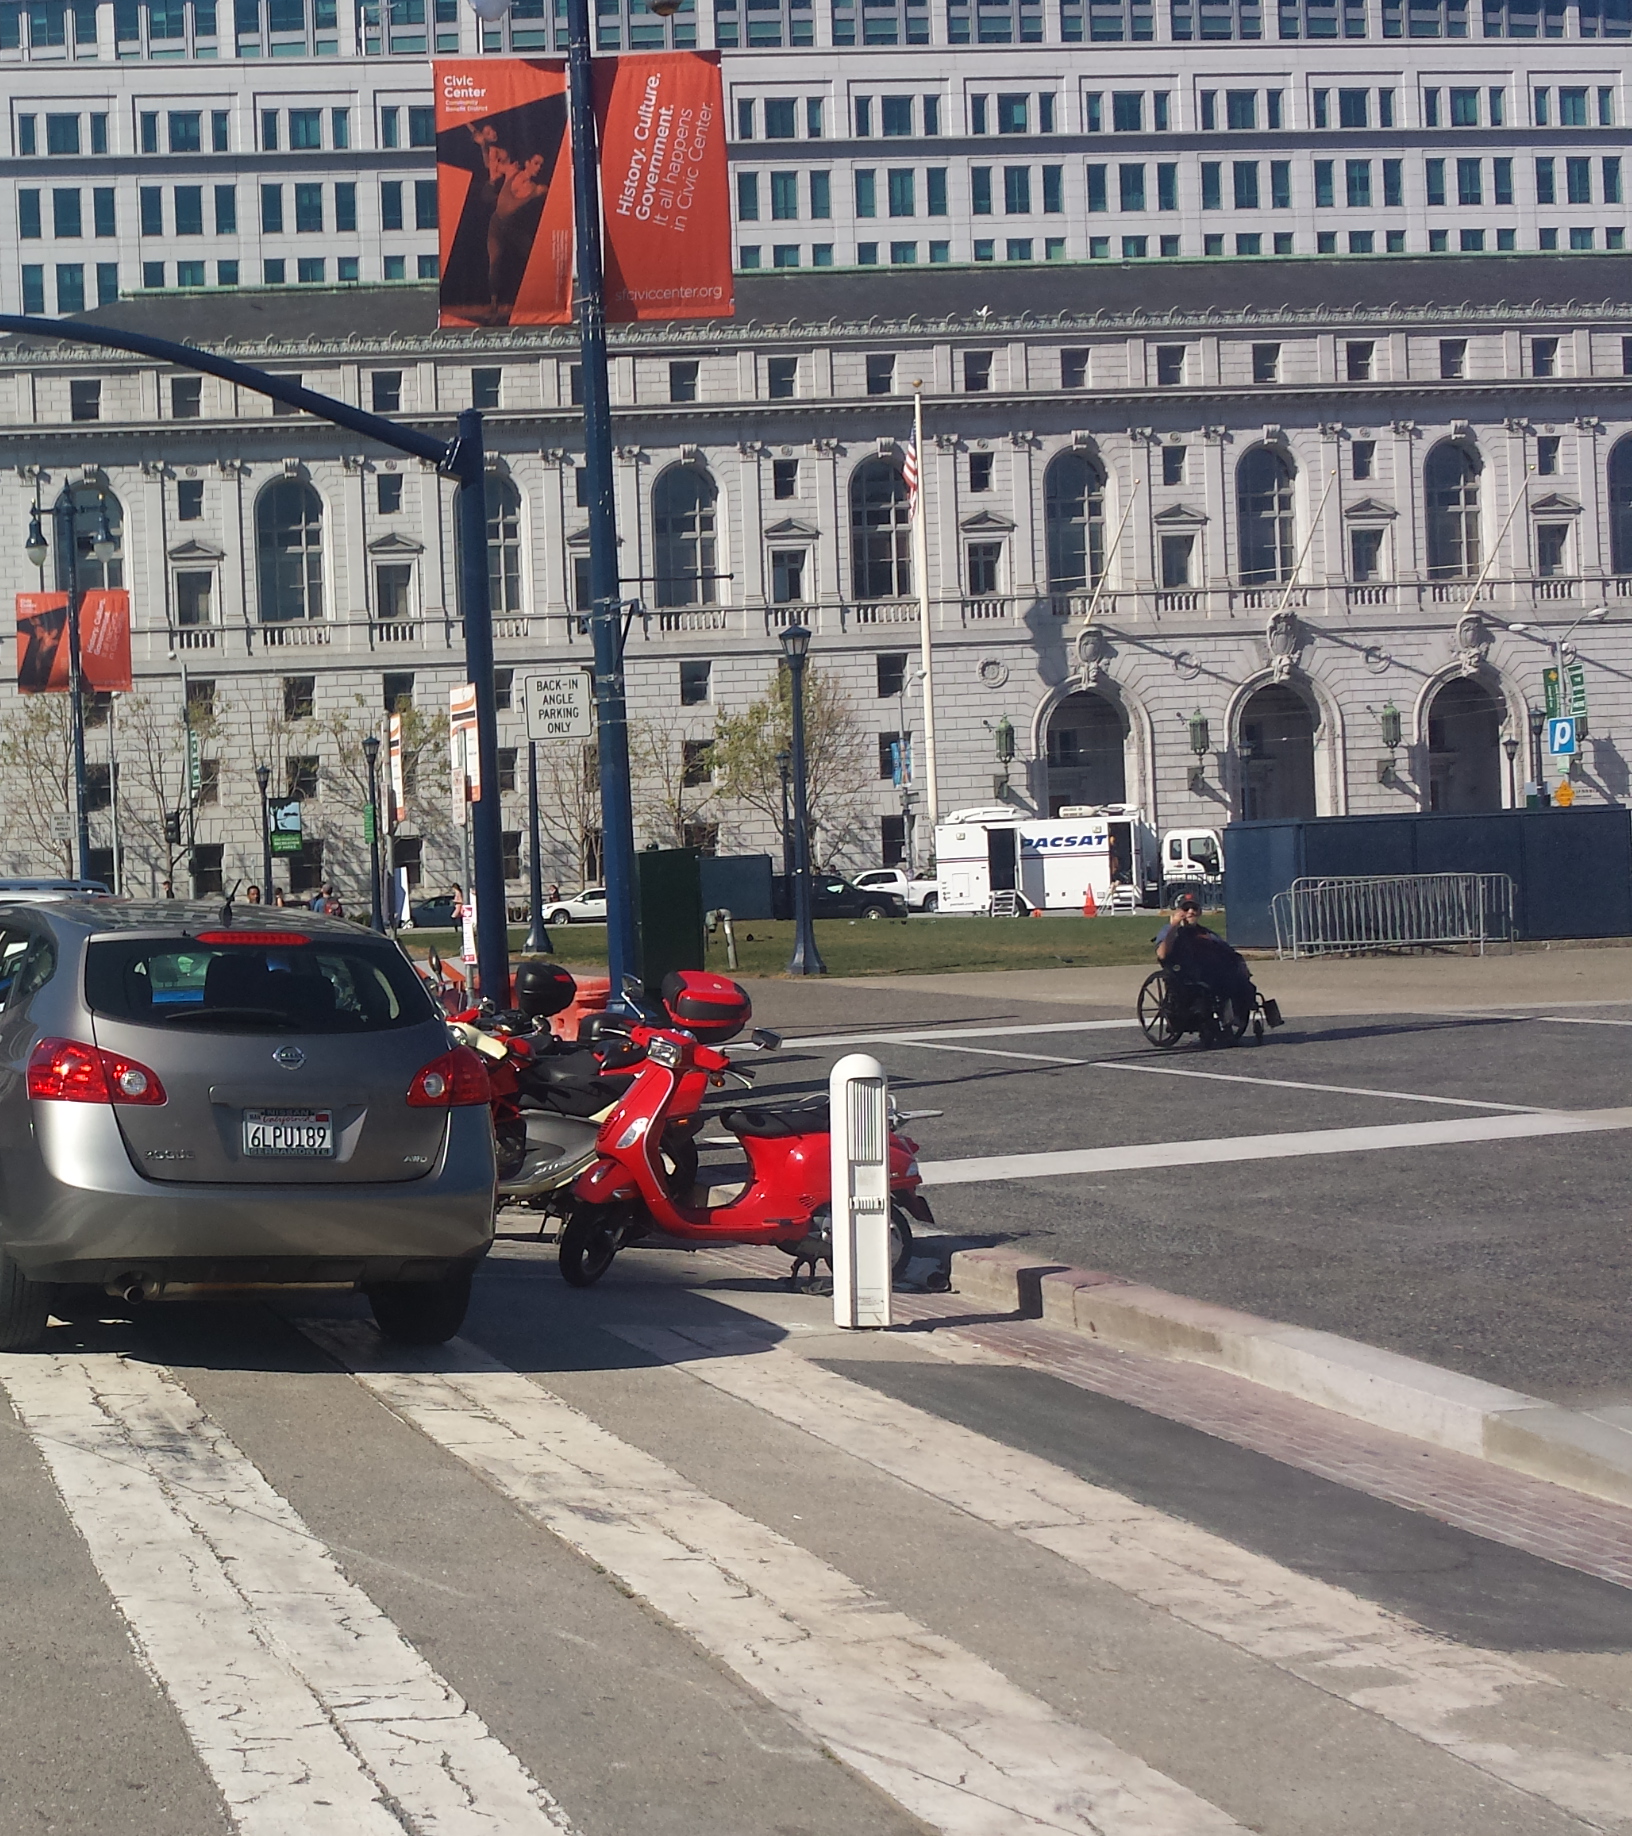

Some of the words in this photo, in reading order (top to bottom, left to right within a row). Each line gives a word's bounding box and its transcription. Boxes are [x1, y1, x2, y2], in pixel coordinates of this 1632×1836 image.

[443, 75, 474, 86] Civic
[444, 87, 487, 98] Center
[688, 102, 714, 162] Center.
[616, 147, 647, 216] History.
[634, 72, 661, 141] Culture.
[663, 108, 693, 185] happens
[635, 104, 675, 221] Government.
[676, 168, 699, 210] Civic
[659, 190, 674, 209] all
[653, 213, 669, 226] It
[670, 216, 688, 232] in
[615, 286, 723, 300] sfciviccenter.org
[536, 679, 578, 691] BACK-IN
[543, 693, 574, 705] ANGLE
[538, 707, 579, 720] PARKING
[548, 722, 571, 733] ONLY
[1553, 721, 1571, 752] P
[1022, 834, 1108, 849] PACSAT
[250, 1126, 326, 1148] 6LPU189
